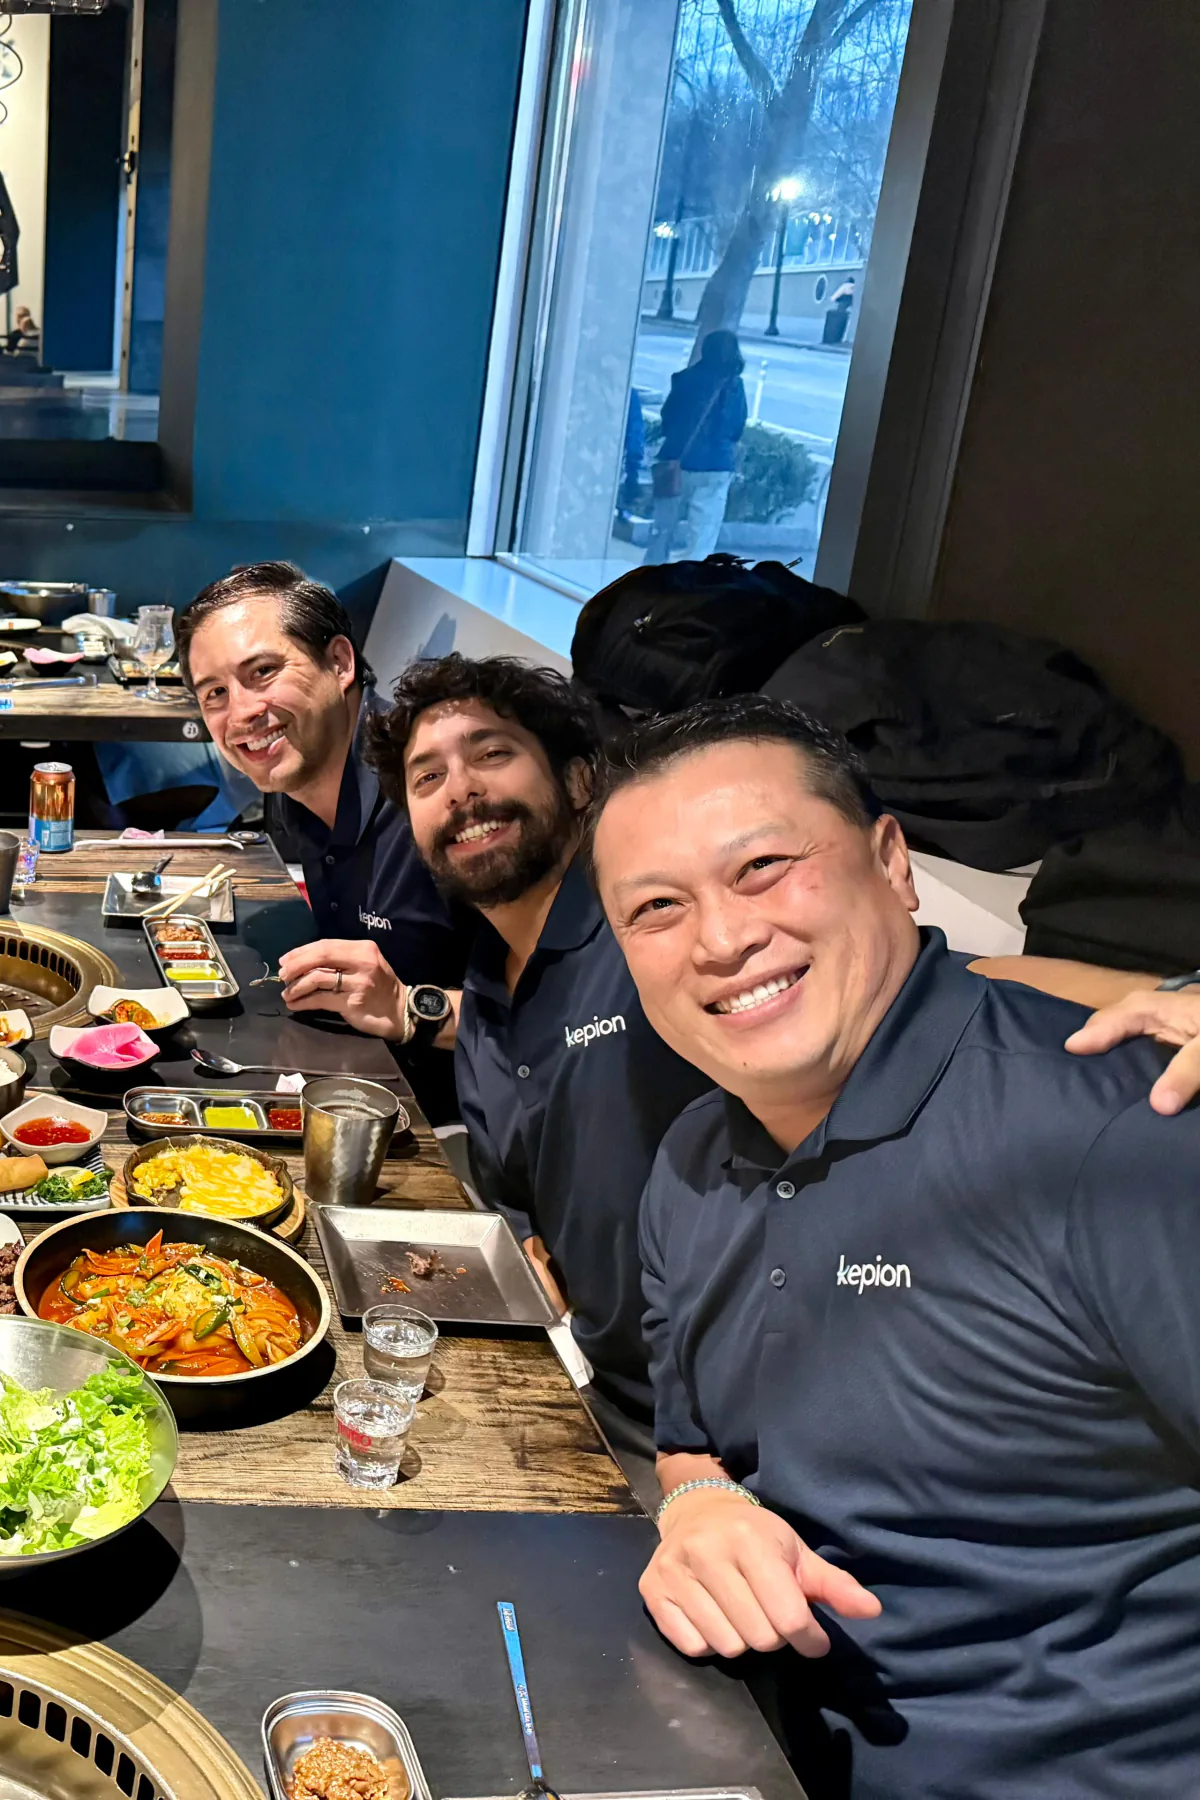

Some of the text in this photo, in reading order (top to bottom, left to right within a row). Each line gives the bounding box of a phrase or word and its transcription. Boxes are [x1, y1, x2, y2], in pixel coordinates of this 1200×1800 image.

[359, 905, 392, 930] kepion
[565, 1014, 626, 1048] kepion
[836, 1254, 911, 1295] kepion
